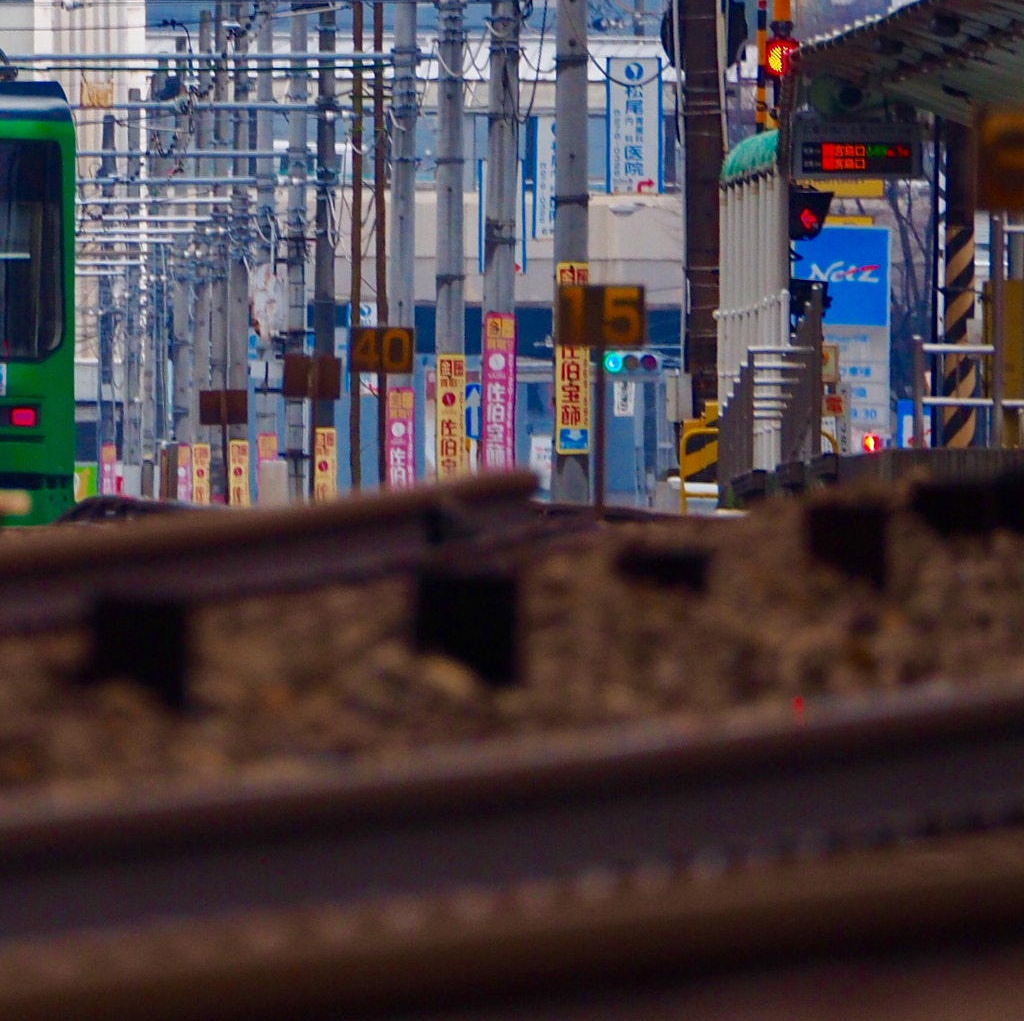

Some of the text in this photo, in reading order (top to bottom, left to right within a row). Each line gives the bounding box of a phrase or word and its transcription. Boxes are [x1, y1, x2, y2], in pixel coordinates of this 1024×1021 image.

[808, 261, 880, 283] Netz
[562, 286, 641, 344] 15
[352, 329, 411, 372] 40
